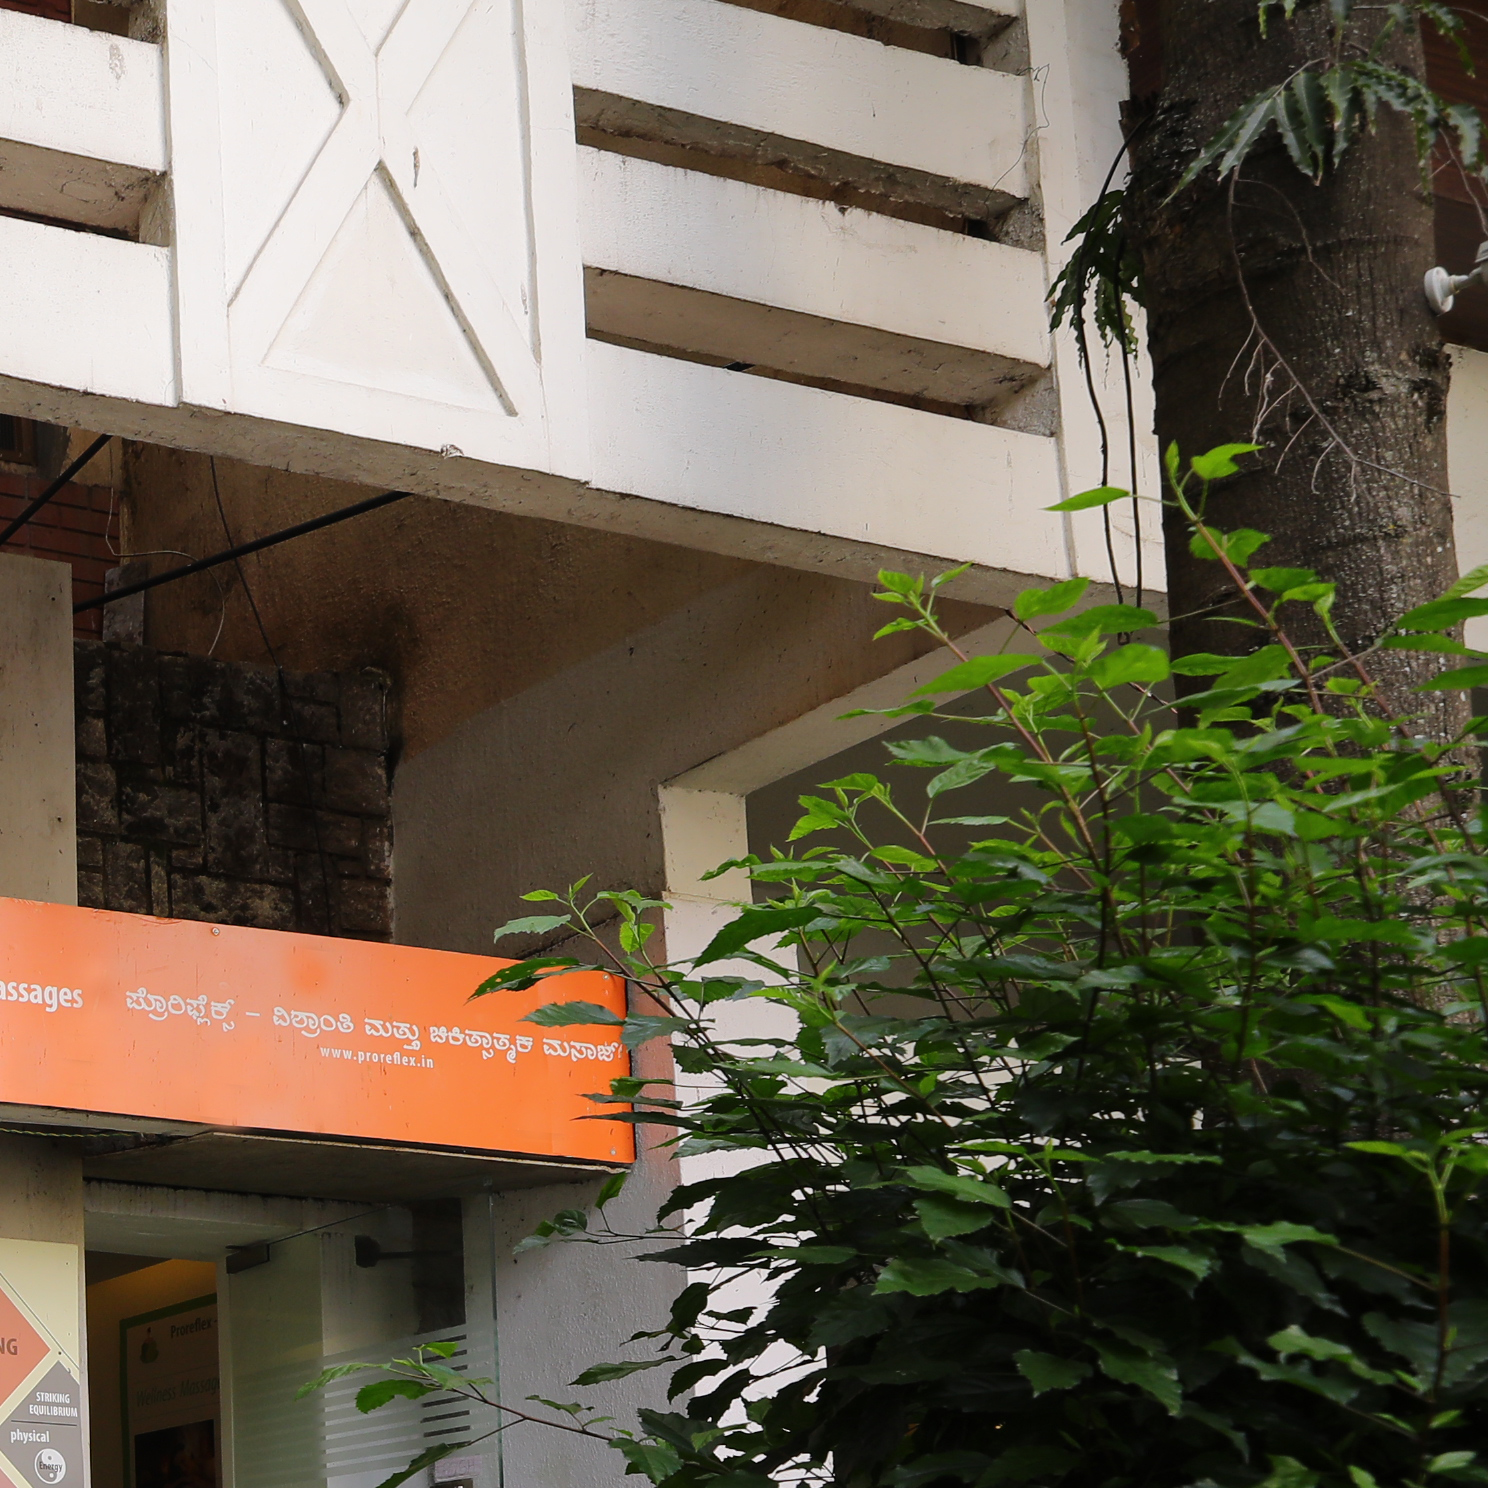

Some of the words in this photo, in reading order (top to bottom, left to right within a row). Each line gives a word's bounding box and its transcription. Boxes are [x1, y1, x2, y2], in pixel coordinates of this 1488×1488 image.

[319, 1046, 434, 1068] www.proreflex.in
[170, 1318, 212, 1338] Proreflex
[36, 1392, 70, 1403] STRIKING
[29, 1405, 78, 1417] EQUILIBRIUM
[10, 1428, 49, 1444] physical
[39, 1461, 62, 1472] Energy
